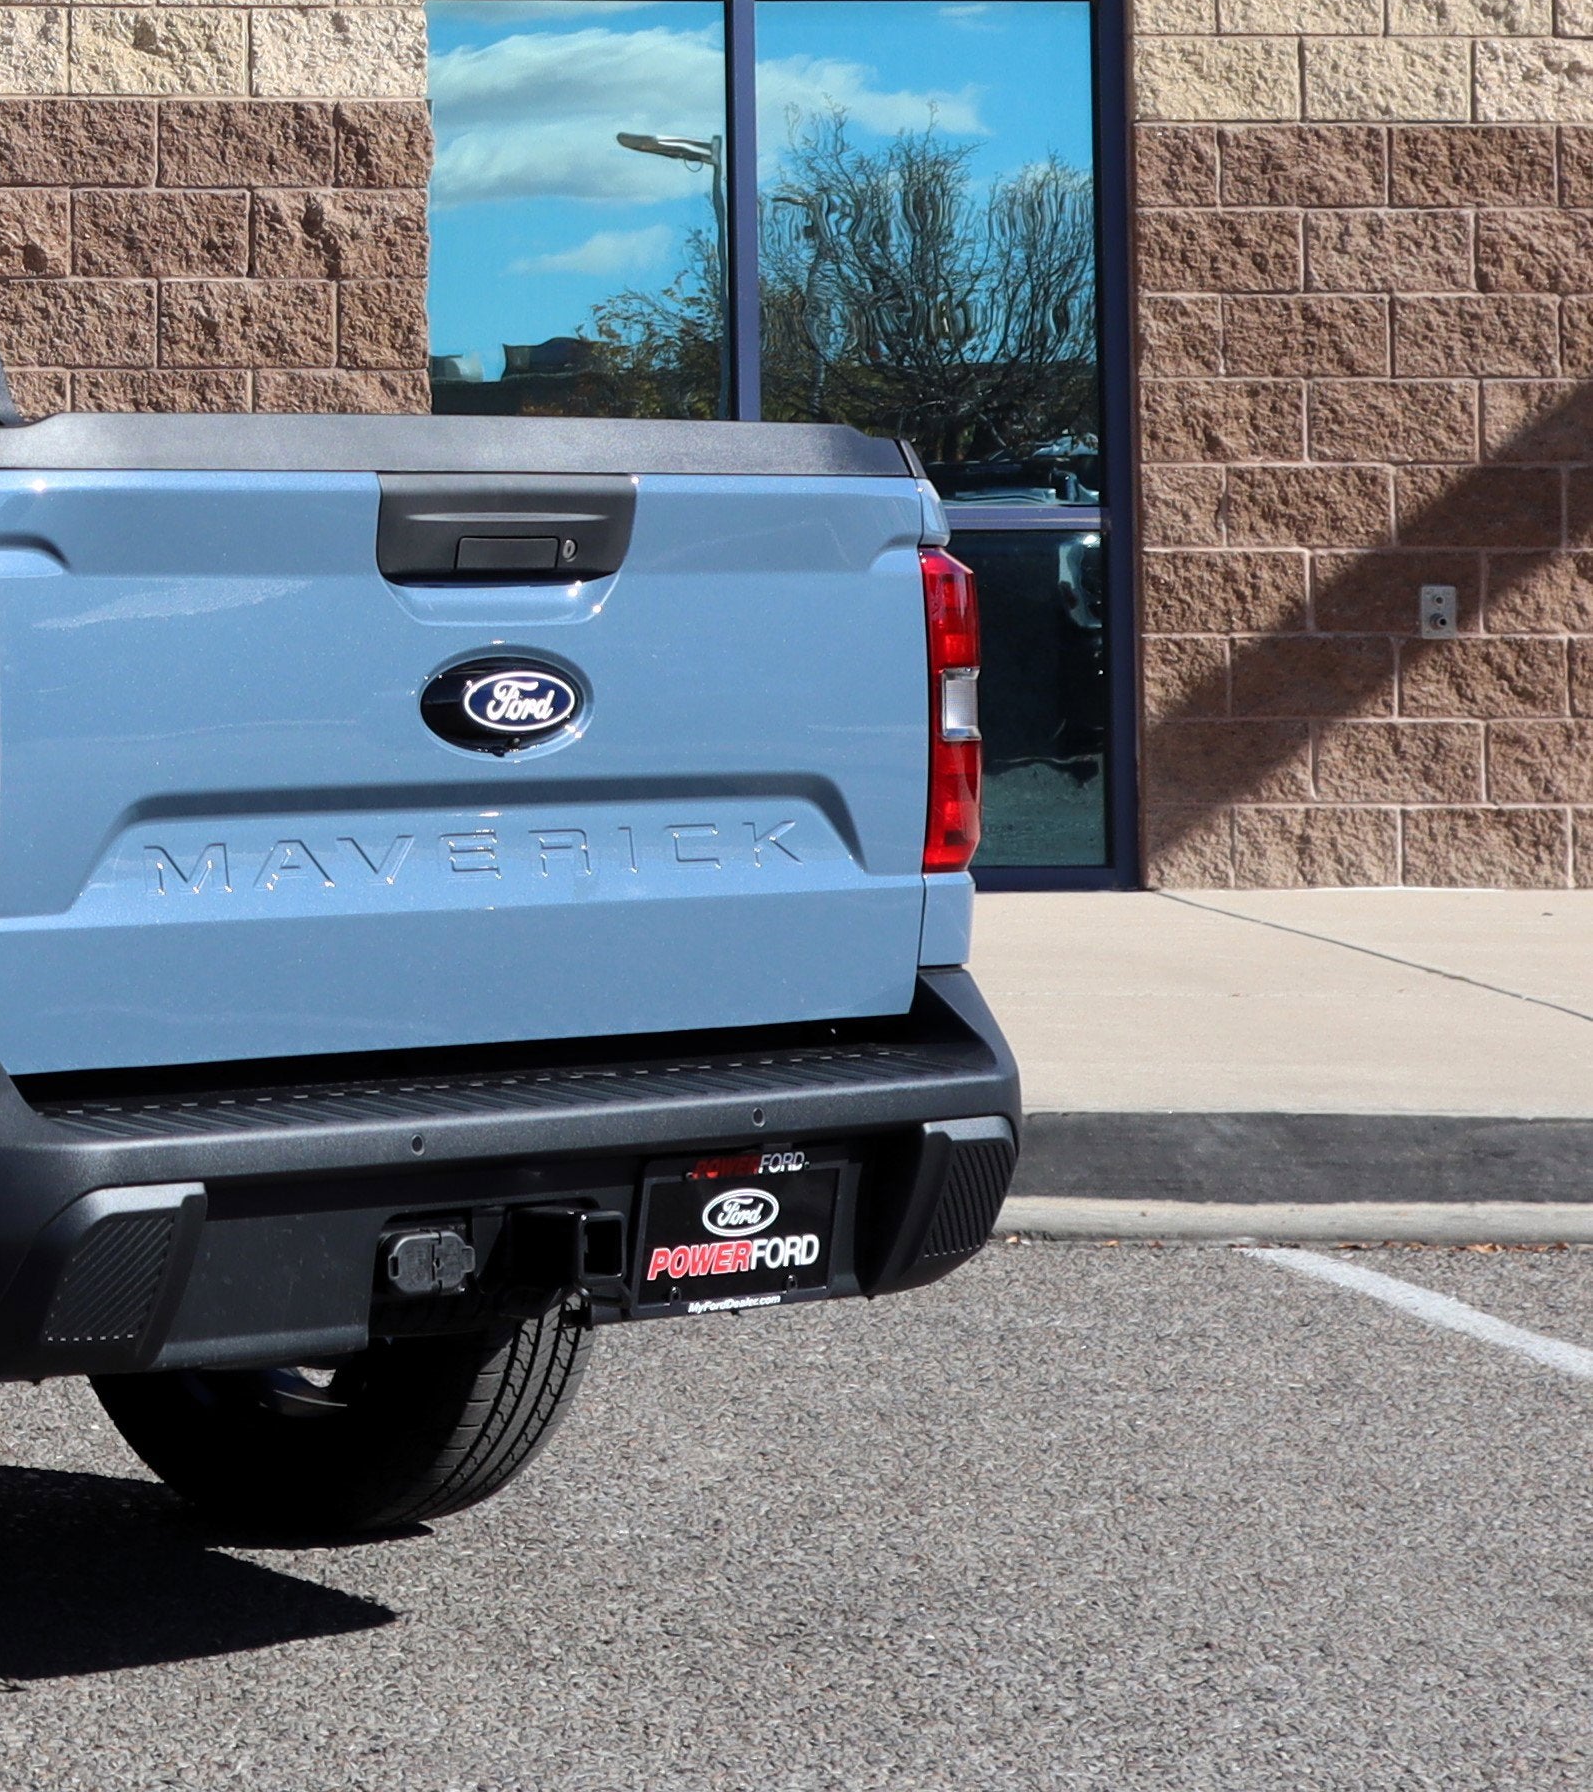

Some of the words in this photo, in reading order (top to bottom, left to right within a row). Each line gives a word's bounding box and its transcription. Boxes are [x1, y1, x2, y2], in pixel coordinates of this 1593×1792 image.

[486, 679, 556, 721] Ford
[143, 819, 803, 895] MAVERICK
[717, 1197, 764, 1227] Ford
[687, 1295, 781, 1314] MyFordDealer.com
